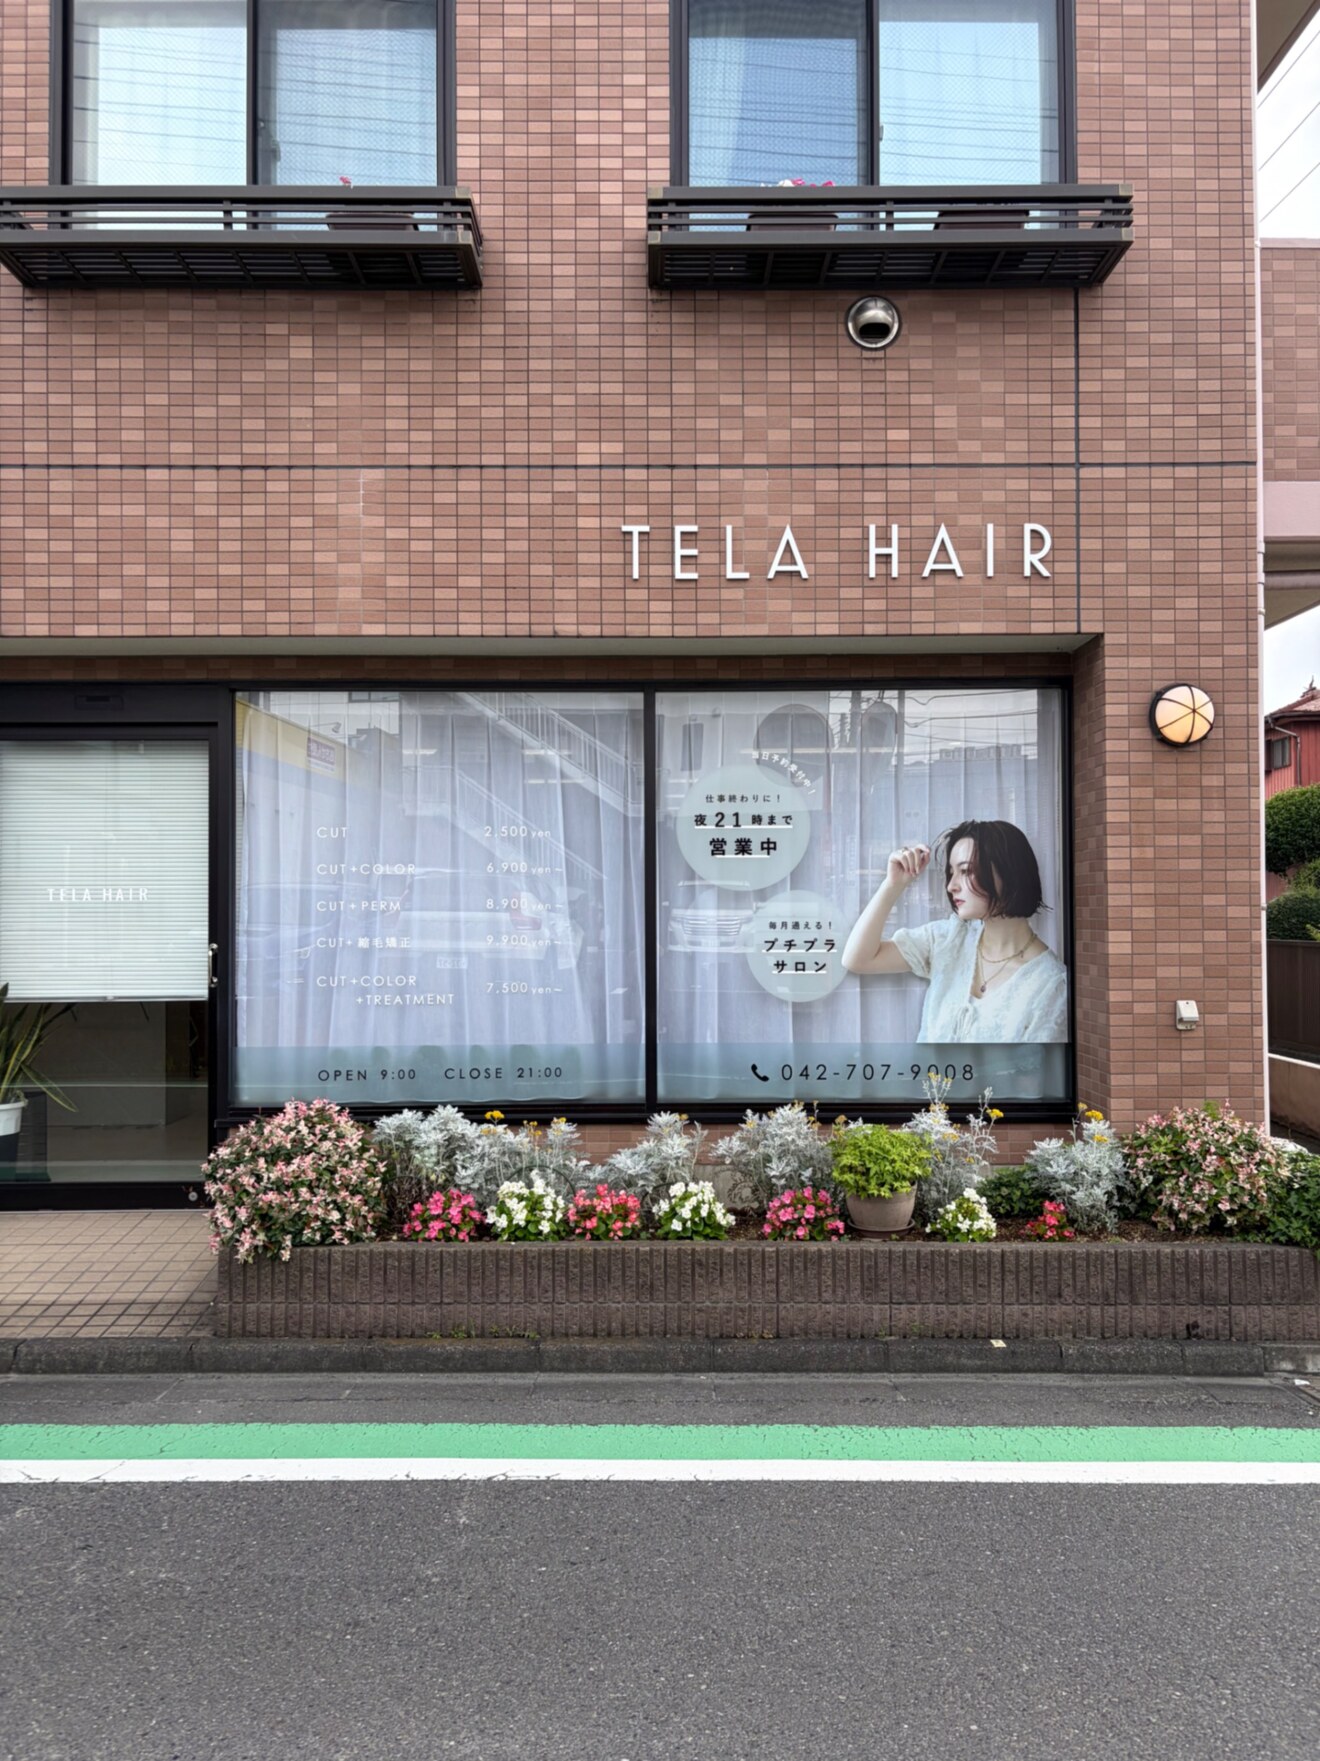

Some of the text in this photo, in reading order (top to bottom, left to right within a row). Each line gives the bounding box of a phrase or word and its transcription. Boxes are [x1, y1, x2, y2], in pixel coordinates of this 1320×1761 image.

[621, 522, 1052, 581] TELA HAIR
[705, 794, 781, 803] 仕事終わりに！
[694, 811, 793, 828] 夜21時まで
[316, 825, 551, 838] CUT 2,500 yen
[709, 837, 777, 856] 営業中
[486, 861, 528, 874] 6,900
[103, 887, 148, 901] HAIR
[486, 898, 528, 910] 8,900
[769, 921, 832, 930] 毎月通える！
[486, 934, 528, 947] 9,900
[764, 937, 836, 952] プチプラ
[773, 960, 827, 973] サロン
[486, 982, 528, 994] 7,500
[355, 994, 455, 1006] +TREATMENT
[317, 1066, 563, 1082] OPEN 9:00 CLOSE 21:00
[781, 1063, 974, 1081] 042-707-9008
